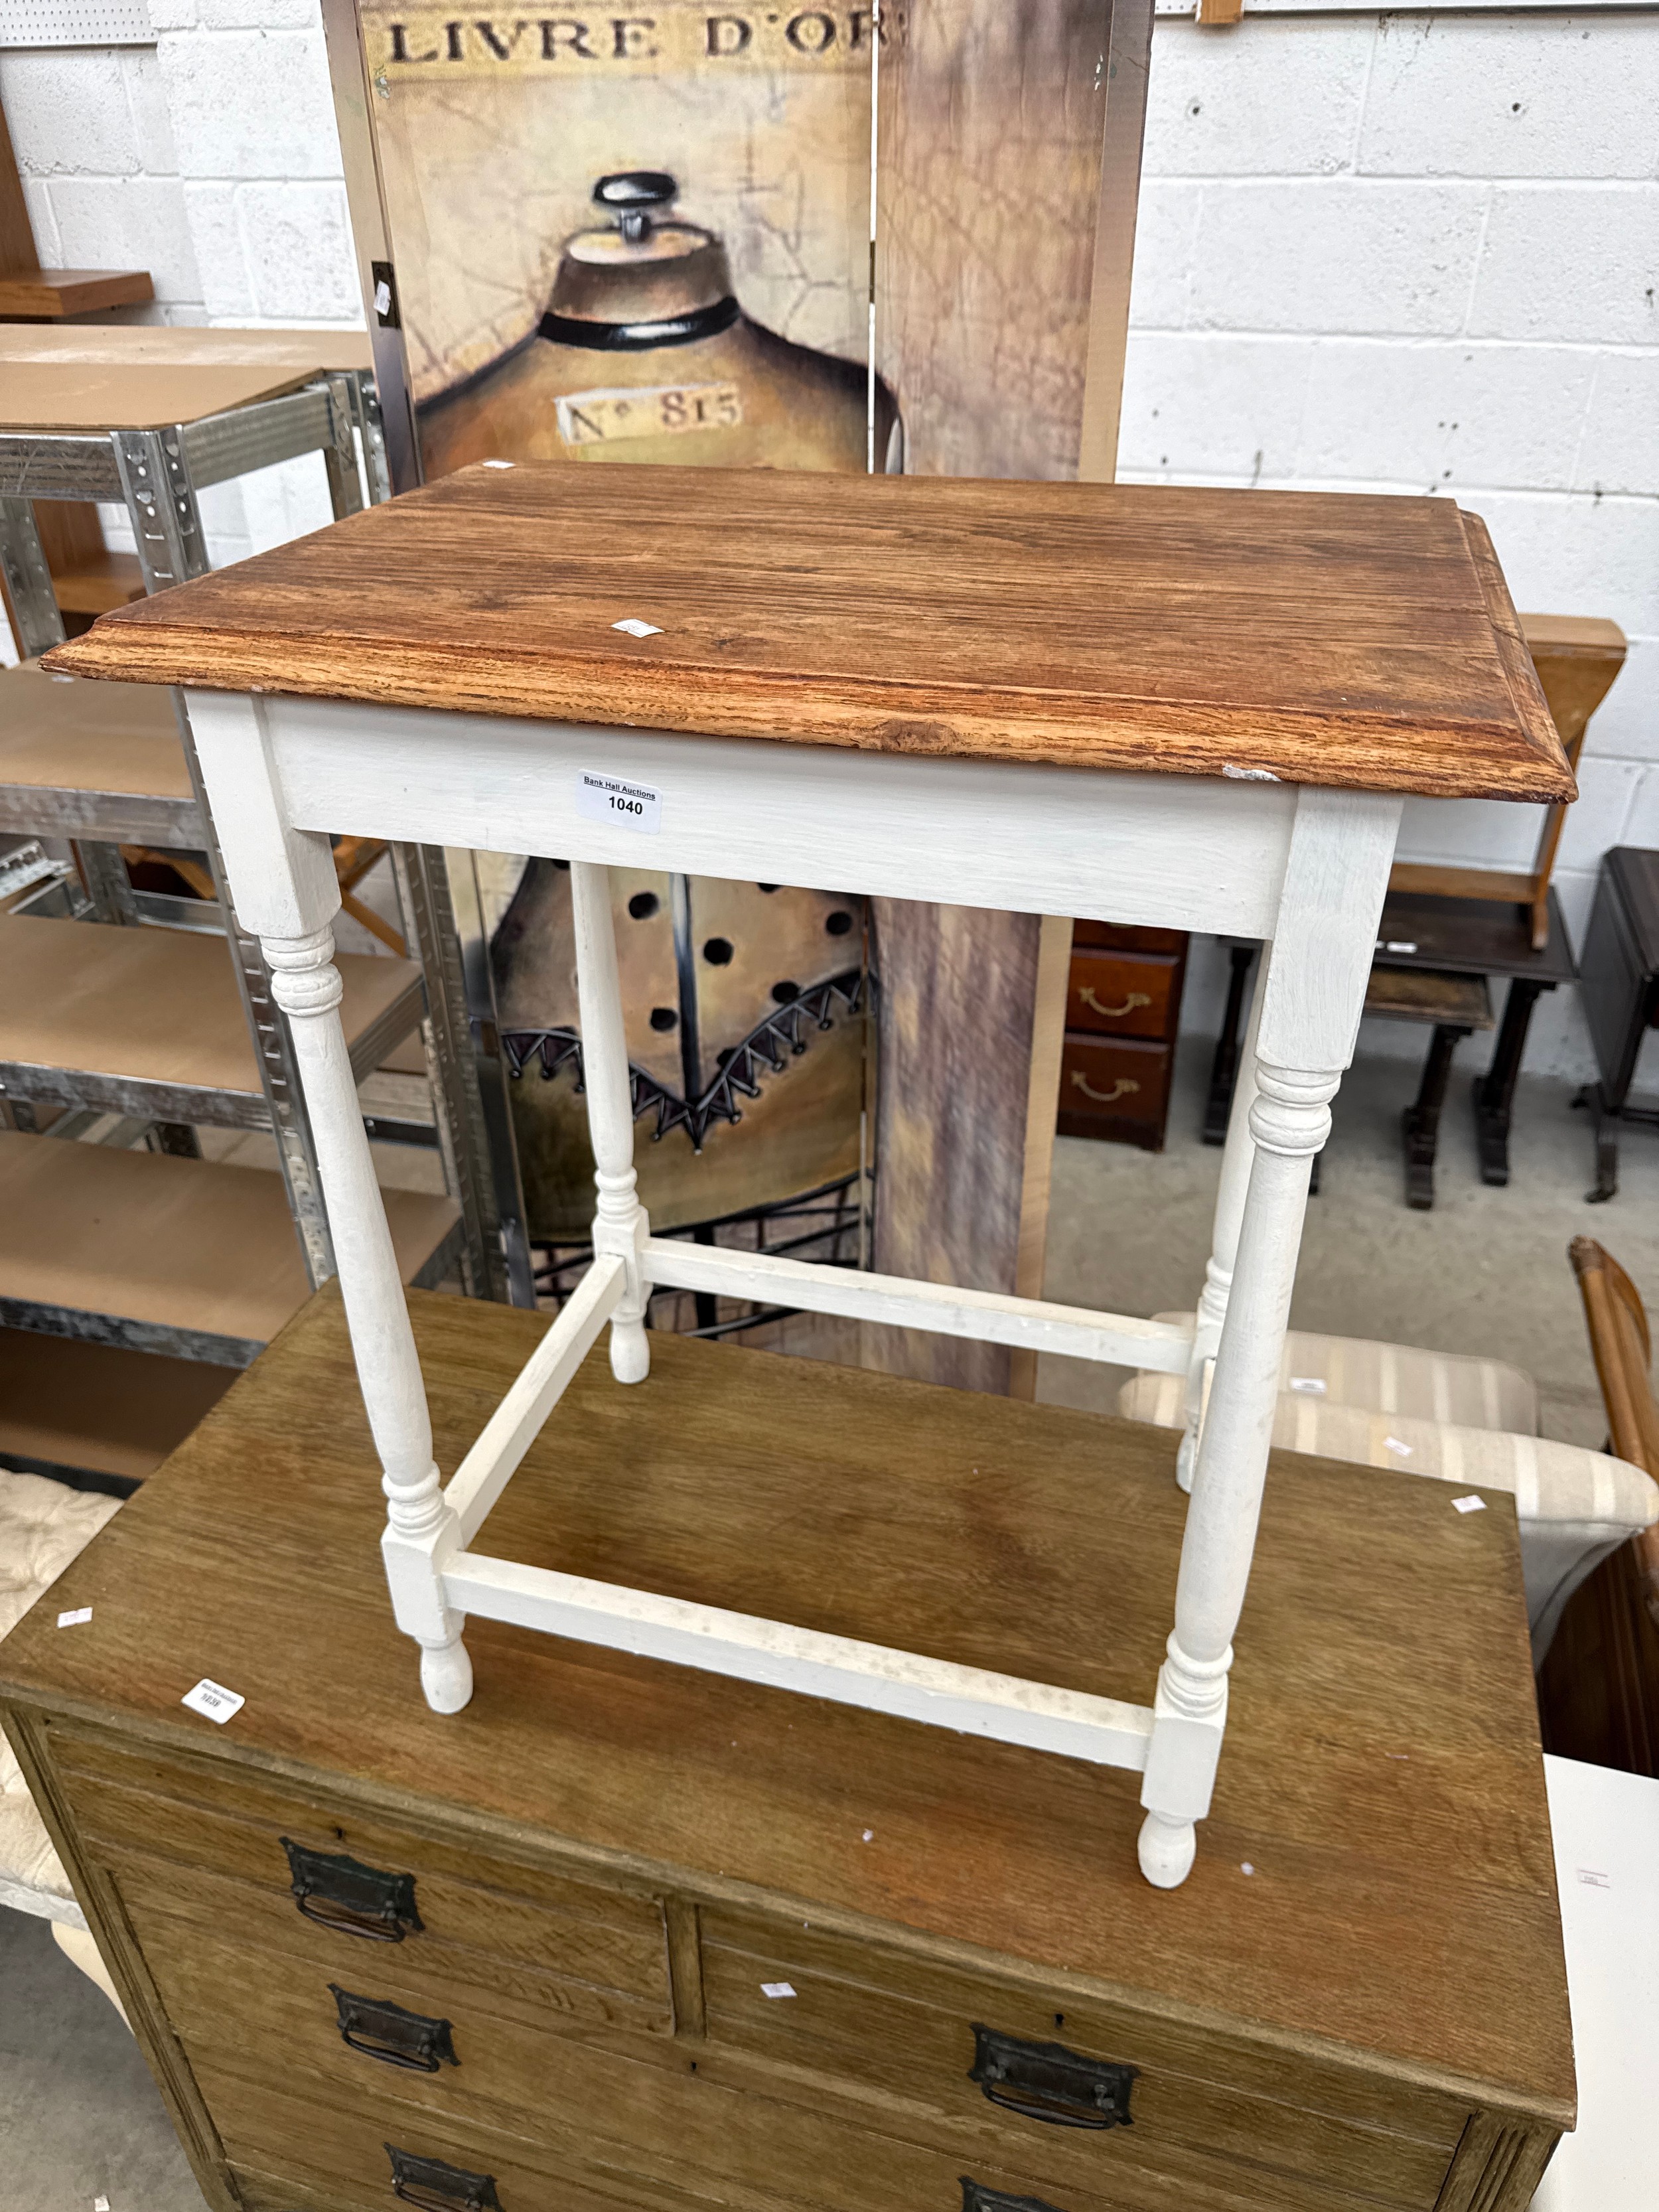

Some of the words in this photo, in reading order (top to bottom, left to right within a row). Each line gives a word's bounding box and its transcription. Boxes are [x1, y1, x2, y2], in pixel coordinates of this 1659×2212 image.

[390, 19, 656, 62] LIVRE
[660, 390, 738, 428] 815
[584, 776, 603, 786] Bank
[605, 781, 620, 791] Hall
[622, 786, 656, 800] Auctions
[609, 796, 642, 815] 1040
